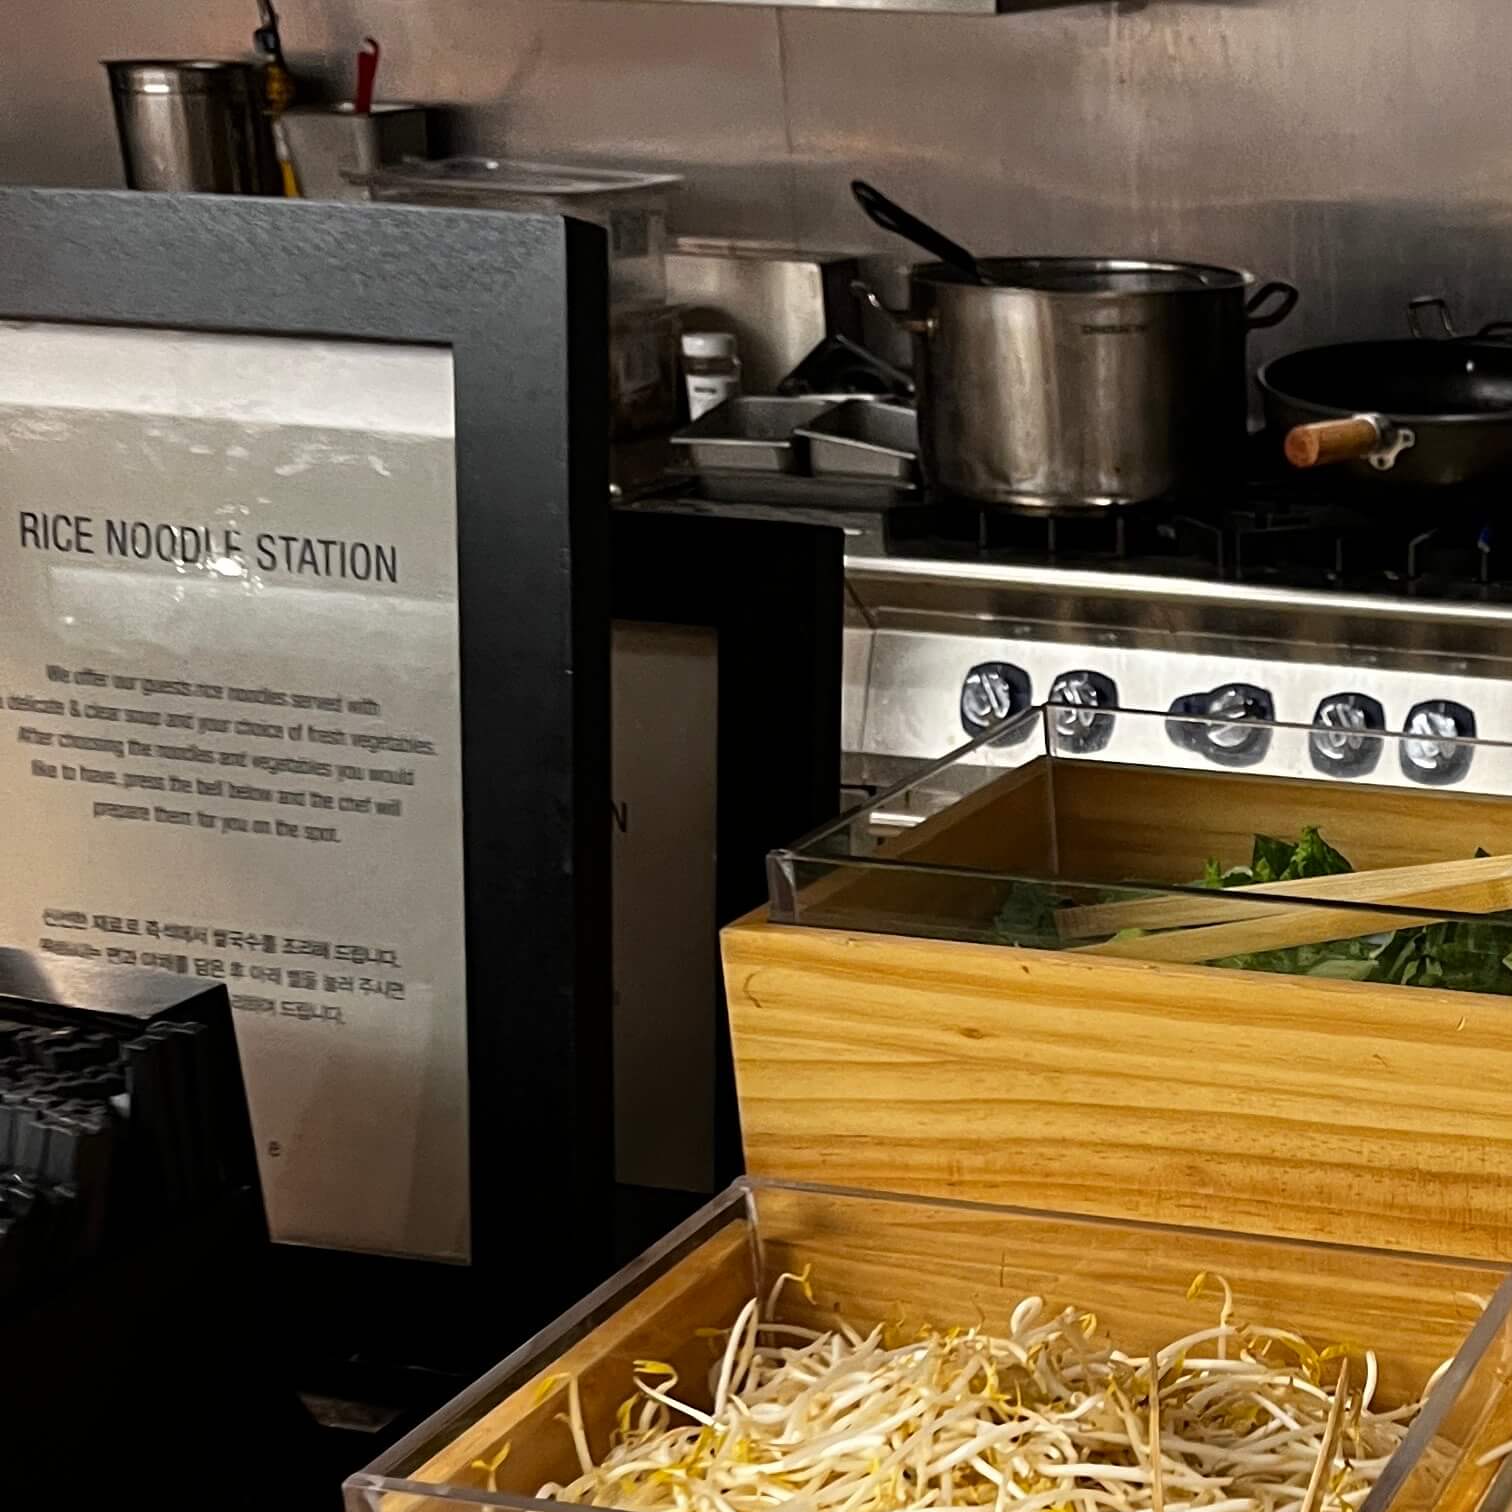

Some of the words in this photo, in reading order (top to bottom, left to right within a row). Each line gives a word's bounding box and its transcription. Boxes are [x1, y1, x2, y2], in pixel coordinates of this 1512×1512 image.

[19, 511, 95, 555] RICE
[105, 518, 243, 567] NOODLE
[256, 533, 399, 583] STATION
